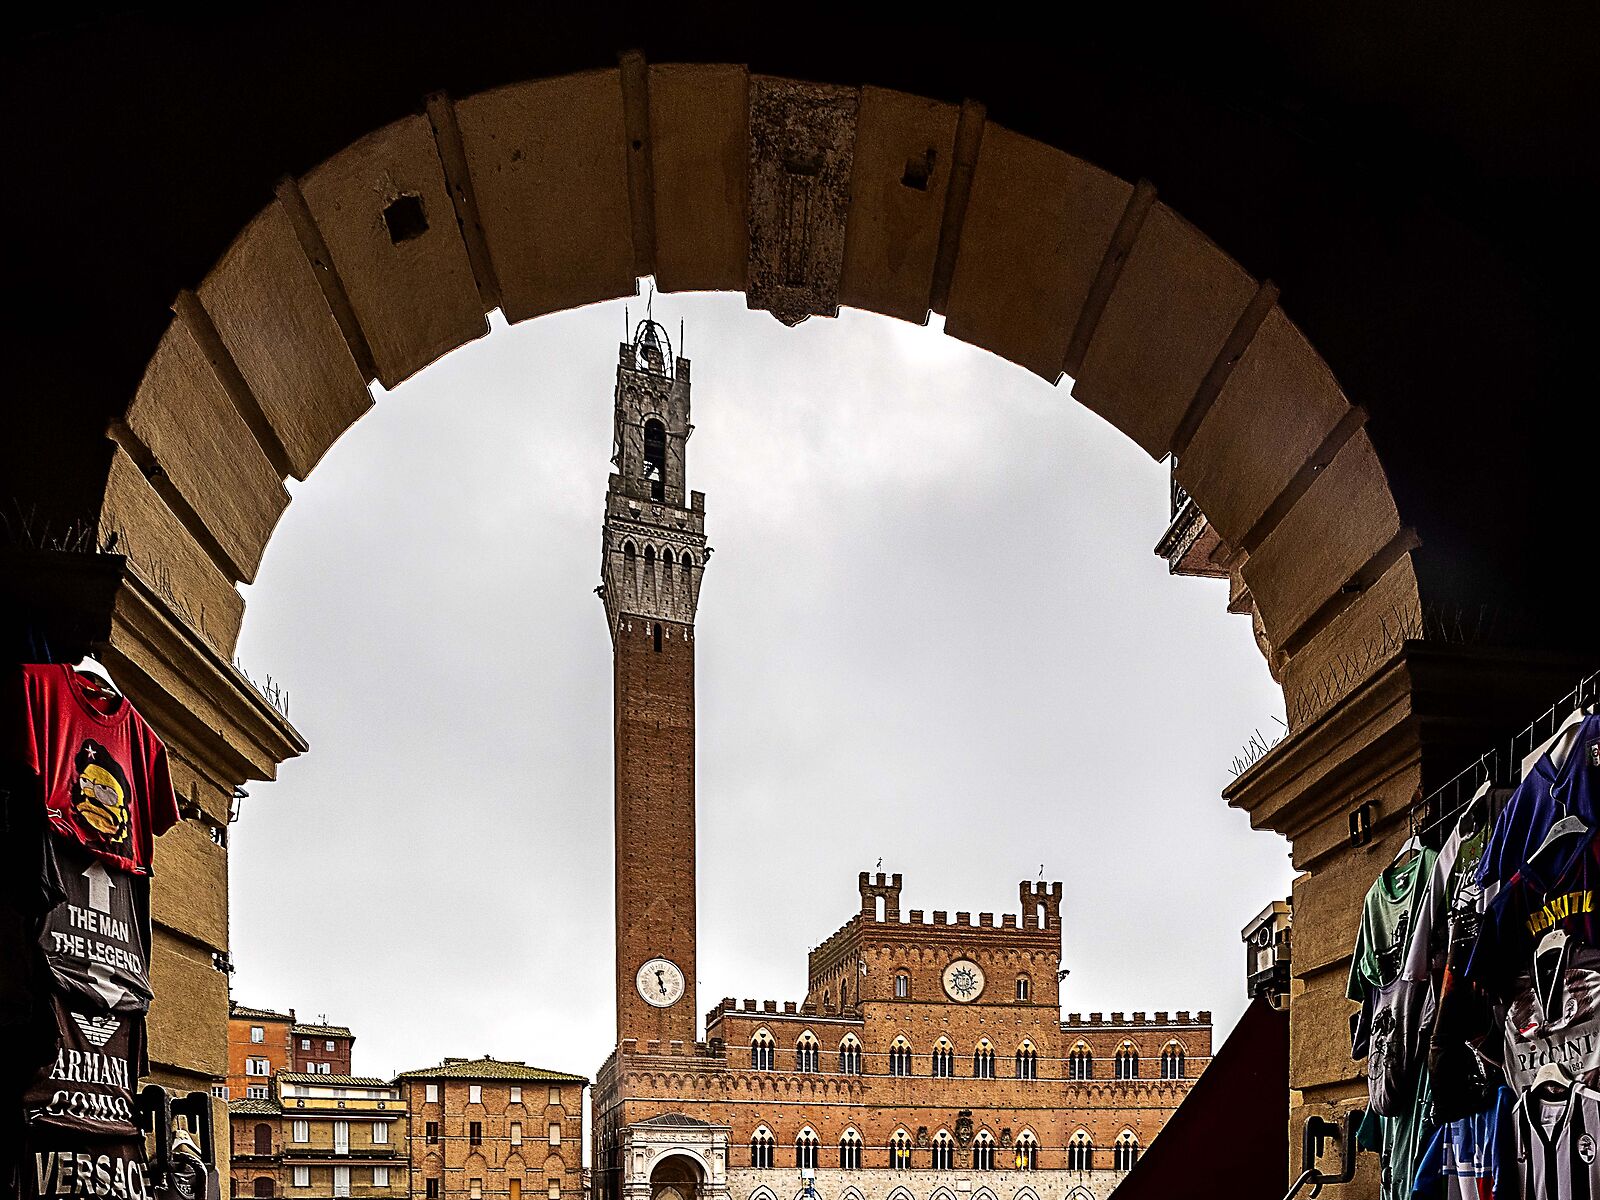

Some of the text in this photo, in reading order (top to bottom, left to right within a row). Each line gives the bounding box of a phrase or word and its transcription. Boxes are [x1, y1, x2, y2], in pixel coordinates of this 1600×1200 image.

[68, 904, 129, 943] THE MAN
[51, 931, 141, 974] THE LEGEND
[49, 1047, 130, 1090] ARMANI
